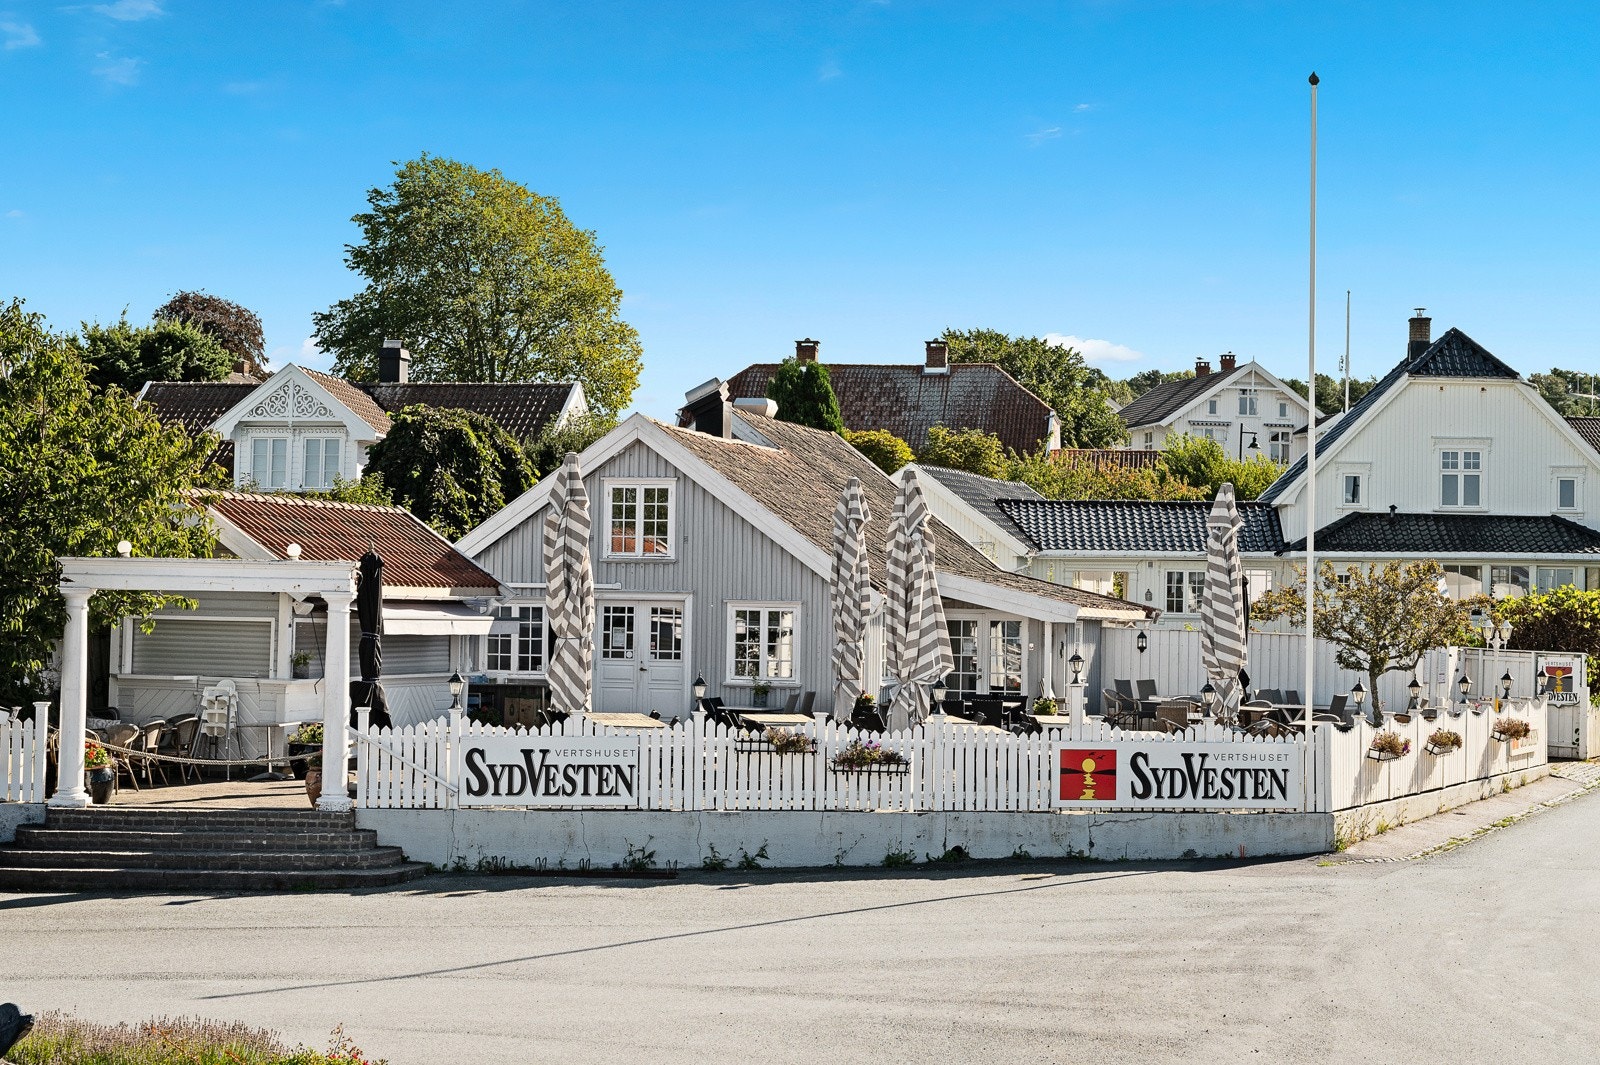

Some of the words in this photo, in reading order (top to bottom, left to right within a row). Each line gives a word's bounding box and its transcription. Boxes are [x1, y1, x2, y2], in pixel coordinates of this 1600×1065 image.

[1548, 690, 1578, 702] DVESTEN
[554, 749, 636, 757] VERTSHUSET
[1213, 753, 1290, 762] VERTSHUSET
